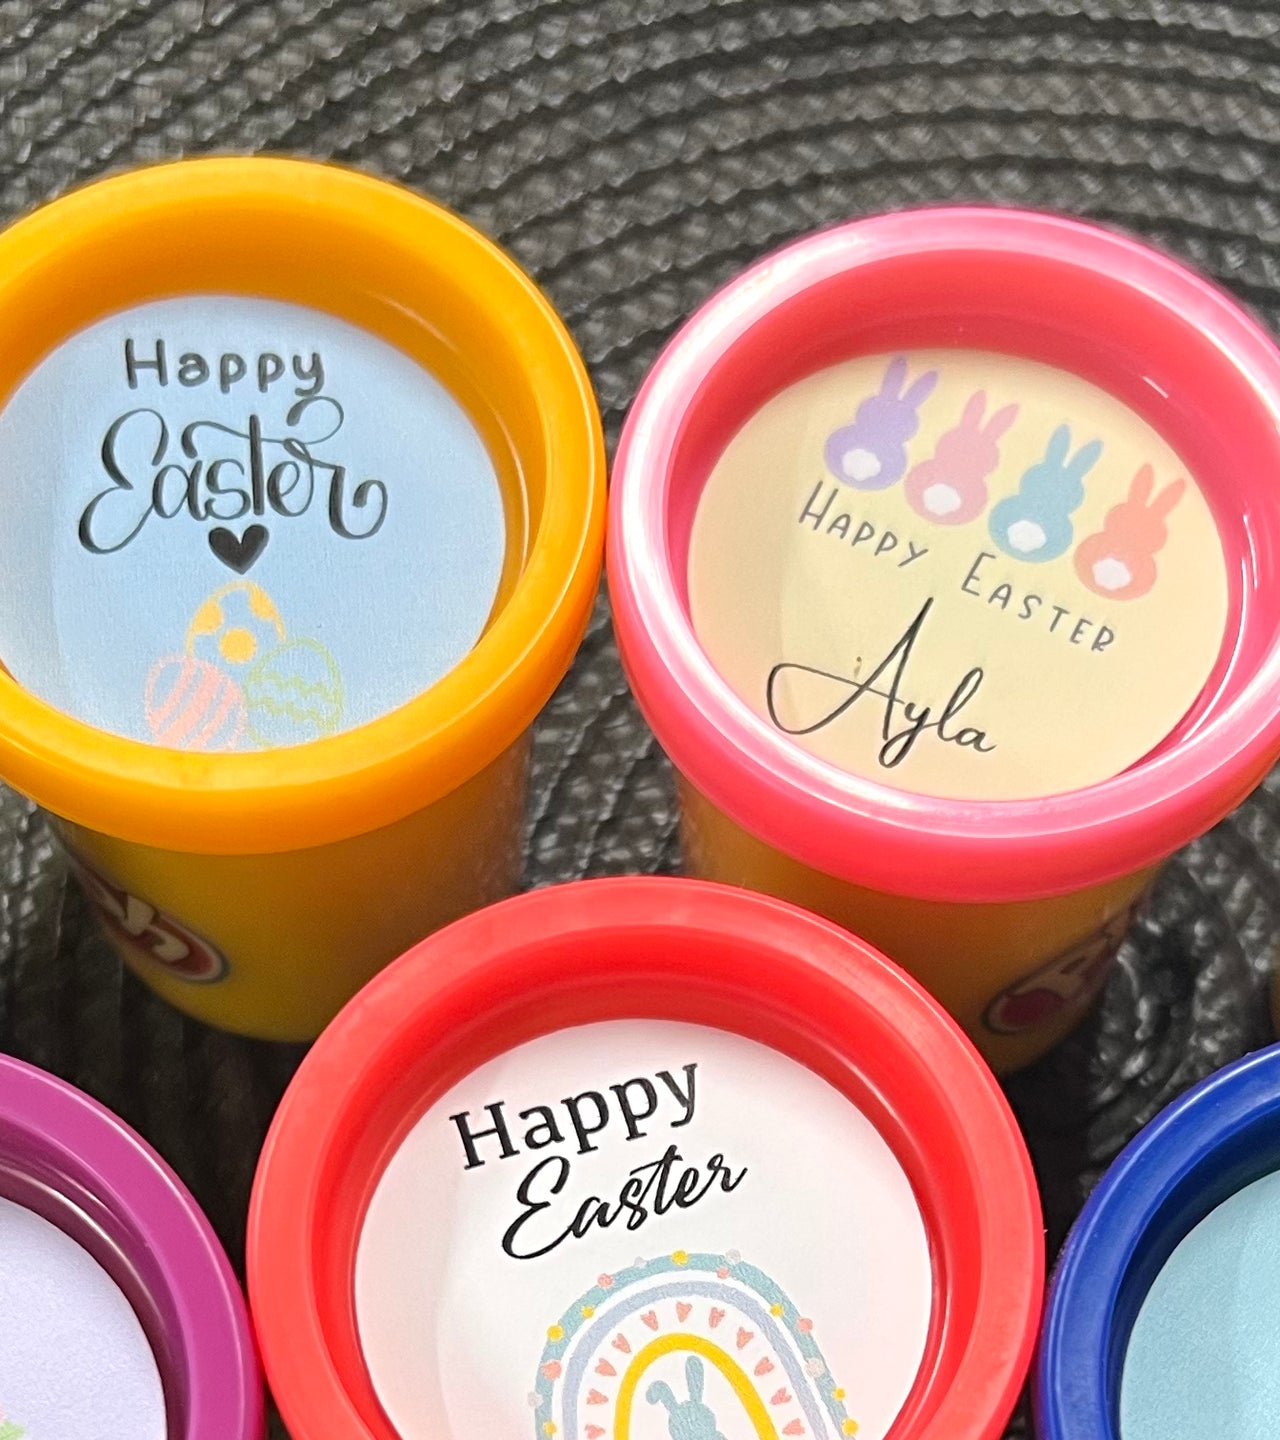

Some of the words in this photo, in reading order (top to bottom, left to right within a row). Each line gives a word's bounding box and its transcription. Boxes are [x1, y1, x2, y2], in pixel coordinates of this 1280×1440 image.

[125, 338, 324, 397] Happy
[78, 396, 388, 555] Easter
[799, 480, 928, 568] HAPPY
[961, 552, 1116, 653] EASTER
[767, 597, 997, 769] Ayla
[449, 1063, 698, 1171] Happy
[502, 1144, 748, 1260] Easter
